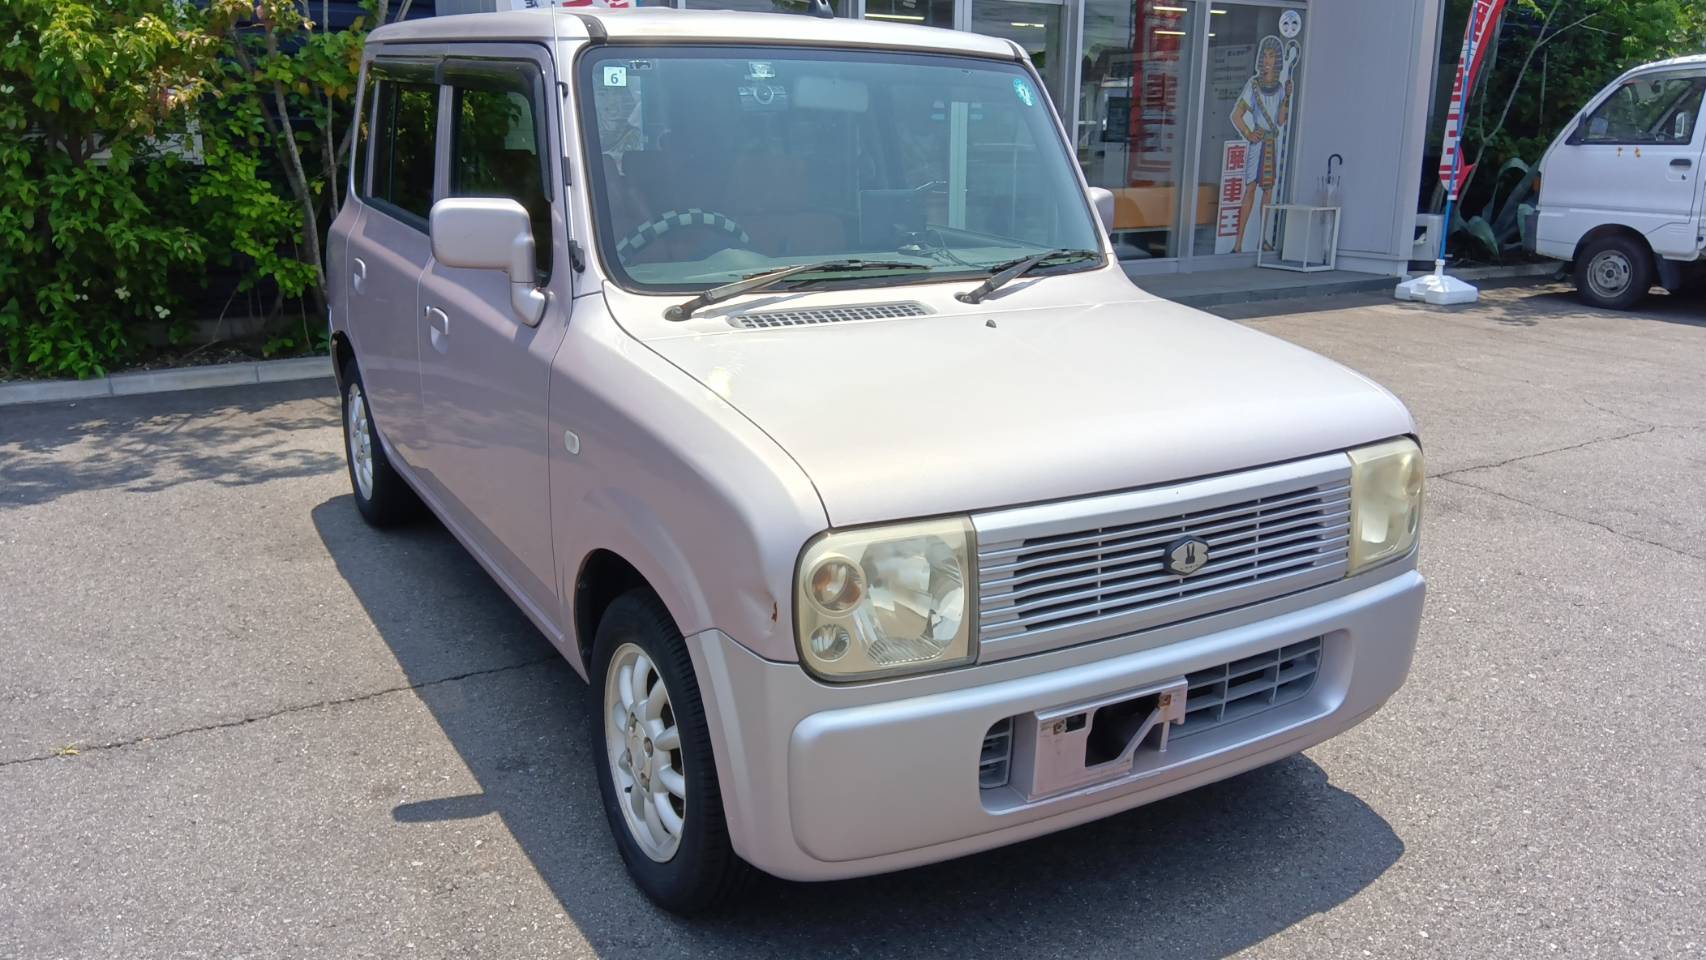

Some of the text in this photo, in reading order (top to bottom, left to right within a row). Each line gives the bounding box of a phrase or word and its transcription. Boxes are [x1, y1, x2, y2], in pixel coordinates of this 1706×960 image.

[610, 73, 619, 84] 6
[1218, 145, 1248, 237] 廃車王
